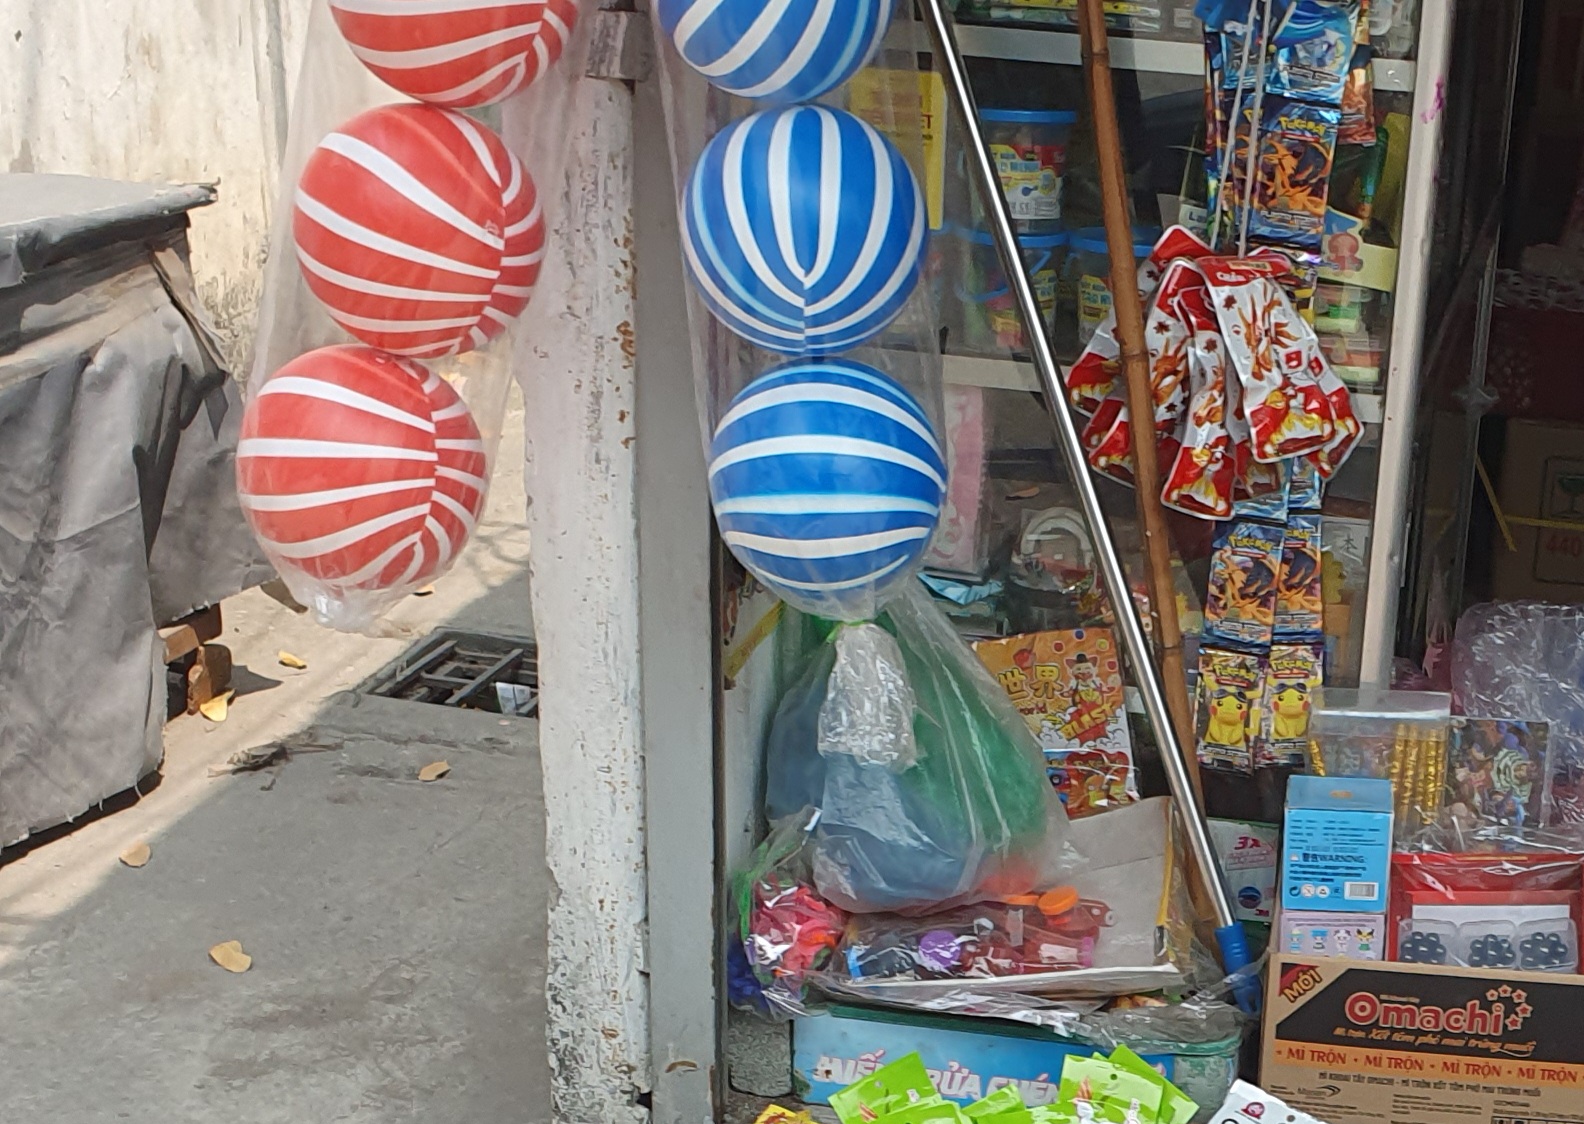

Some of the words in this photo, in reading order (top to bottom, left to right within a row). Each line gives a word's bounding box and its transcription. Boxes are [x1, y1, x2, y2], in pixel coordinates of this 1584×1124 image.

[1345, 991, 1506, 1036] Omachi
[1286, 1046, 1305, 1061] MÌ
[1307, 1048, 1346, 1066] TRỘN
[1364, 1053, 1383, 1068] MÌ
[1386, 1056, 1424, 1073] TRỘN
[1441, 1060, 1461, 1075] MÌ
[1463, 1063, 1500, 1079] TRỘN
[1517, 1065, 1537, 1080] MÌ
[1540, 1068, 1577, 1084] TRỘN
